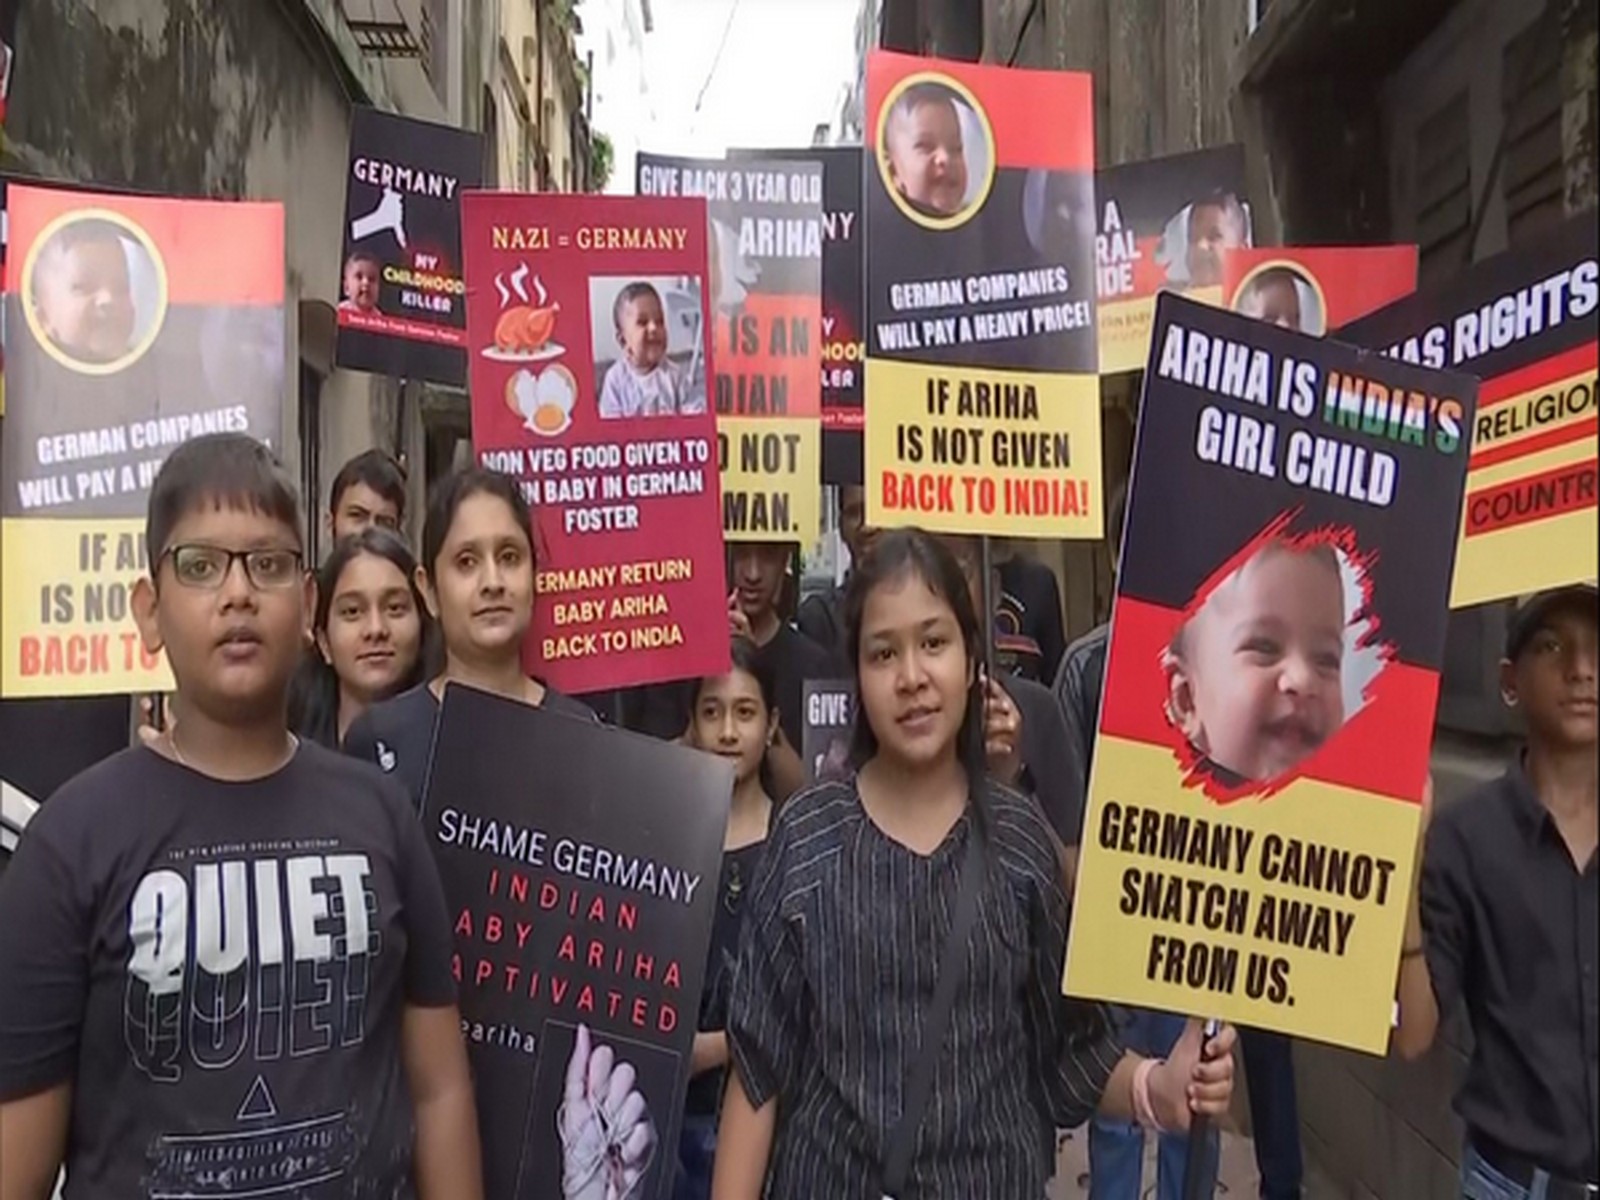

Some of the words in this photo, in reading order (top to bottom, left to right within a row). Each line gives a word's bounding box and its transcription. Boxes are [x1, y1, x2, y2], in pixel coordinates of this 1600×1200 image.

[353, 158, 457, 199] GERMANY
[640, 165, 679, 197] GIVE
[681, 167, 727, 200] BACK
[730, 171, 743, 203] 3
[746, 172, 788, 203] YEAR
[790, 173, 822, 204] OLD
[737, 217, 822, 257] ARIHA
[822, 212, 854, 240] NY
[1104, 201, 1121, 232] A
[492, 227, 550, 249] NAZI
[559, 235, 569, 247] =
[577, 227, 687, 249] GERMANY
[1096, 230, 1142, 264] RAL
[383, 266, 465, 295] CHILDHOOD
[415, 253, 437, 270] MY
[1096, 264, 1134, 297] IDE
[401, 290, 452, 313] KILLER
[891, 279, 963, 310] GERMAN
[966, 267, 1068, 304] COMPANIES
[823, 318, 834, 336] Y
[878, 321, 921, 350] WILL
[923, 317, 957, 346] PAY
[959, 316, 974, 342] A
[976, 310, 1029, 341] HEAVY
[1032, 301, 1091, 334] PRICE!
[1453, 260, 1598, 365] RIGHTS
[730, 316, 759, 356] IS
[770, 317, 809, 357] AN
[716, 373, 787, 417] DIAN
[822, 369, 854, 388] LER
[1159, 324, 1272, 406] ARIHA
[1278, 359, 1316, 417] IS
[1323, 371, 1463, 454] INDIA'S
[927, 378, 949, 415] IF
[957, 380, 1039, 421] ARIHA
[37, 425, 126, 464] GERMAN
[130, 405, 248, 449] COMPANIES
[741, 433, 801, 474] NOT
[898, 424, 923, 461] IS
[932, 427, 984, 464] NOT
[992, 431, 1070, 469] GIVEN
[482, 451, 524, 475] NON
[528, 448, 567, 473] VEG
[572, 444, 621, 470] FOOD
[625, 441, 680, 467] GIVEN
[684, 439, 708, 463] TO
[1197, 406, 1276, 478] GIRL
[1286, 431, 1397, 507] CHILD
[18, 474, 73, 508] WILL
[76, 467, 116, 499] PAY
[121, 465, 136, 492] A
[544, 477, 598, 504] BABY
[602, 475, 622, 499] IN
[626, 470, 703, 498] GERMAN
[882, 472, 954, 511] BACK
[961, 477, 996, 515] TO
[1004, 478, 1089, 516] INDIA!
[565, 506, 639, 533] FOSTER
[724, 492, 799, 533] MAN.
[79, 533, 107, 571] IF
[536, 565, 617, 593] ERMANY
[620, 559, 692, 585] RETURN
[41, 583, 75, 624] IS
[85, 582, 134, 622] NO
[553, 601, 605, 626] BABY
[610, 594, 668, 619] ARIHA
[20, 635, 109, 677] BACK
[120, 632, 159, 671] TO
[542, 636, 598, 660] BACK
[601, 631, 627, 652] TO
[630, 624, 683, 649] INDIA
[808, 693, 848, 726] GIVE
[438, 808, 547, 867] SHAME
[553, 839, 700, 904] GERMANY
[1099, 802, 1254, 875] GERMANY
[1259, 834, 1396, 905] CANNOT
[488, 869, 637, 932] INDIAN
[1120, 868, 1249, 935] SNATCH
[1253, 895, 1355, 957] AWAY
[128, 854, 371, 997] QUIET
[455, 908, 532, 948] ABY
[558, 935, 681, 989] ARIHA
[1146, 934, 1240, 995] FROM
[1245, 953, 1295, 1007] US.
[452, 953, 677, 1033] APTIVATED
[461, 1019, 535, 1053] eariha
